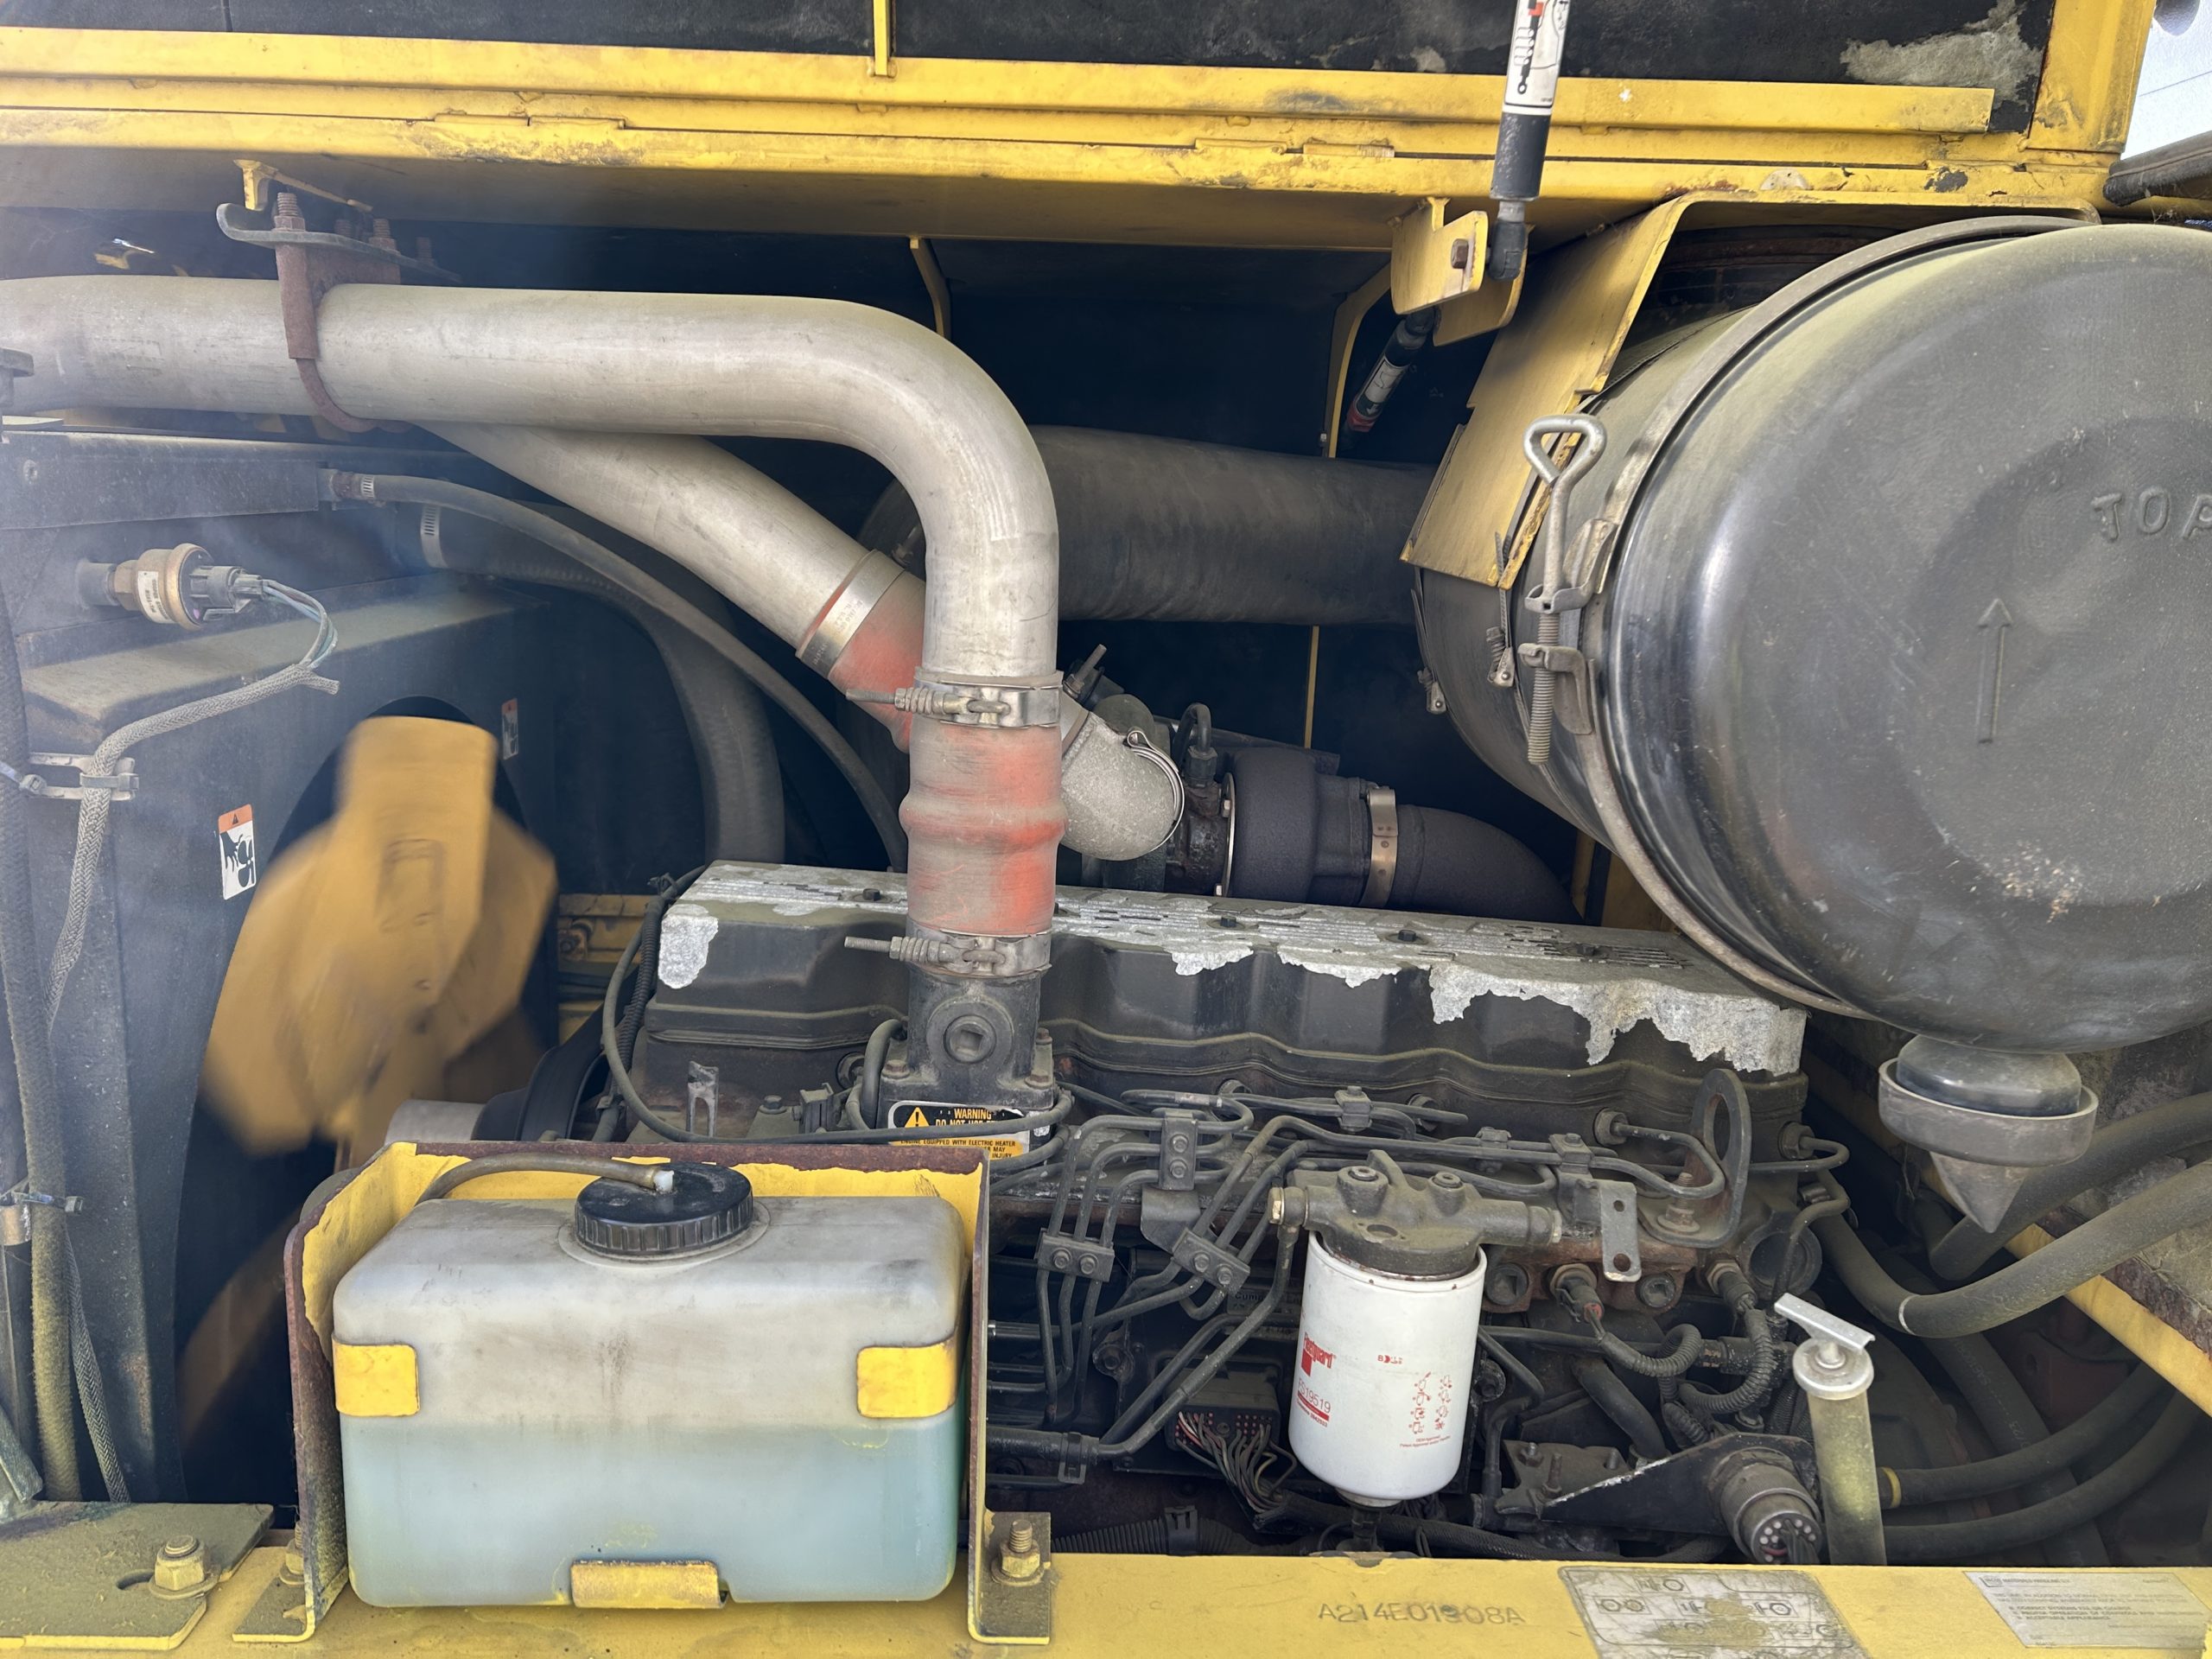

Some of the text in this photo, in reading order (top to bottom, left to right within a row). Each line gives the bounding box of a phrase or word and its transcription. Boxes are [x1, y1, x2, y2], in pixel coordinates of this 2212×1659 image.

[2091, 487, 2212, 543] TOP
[954, 1108, 992, 1120] WARNING
[1298, 1377, 1331, 1413] FS19519
